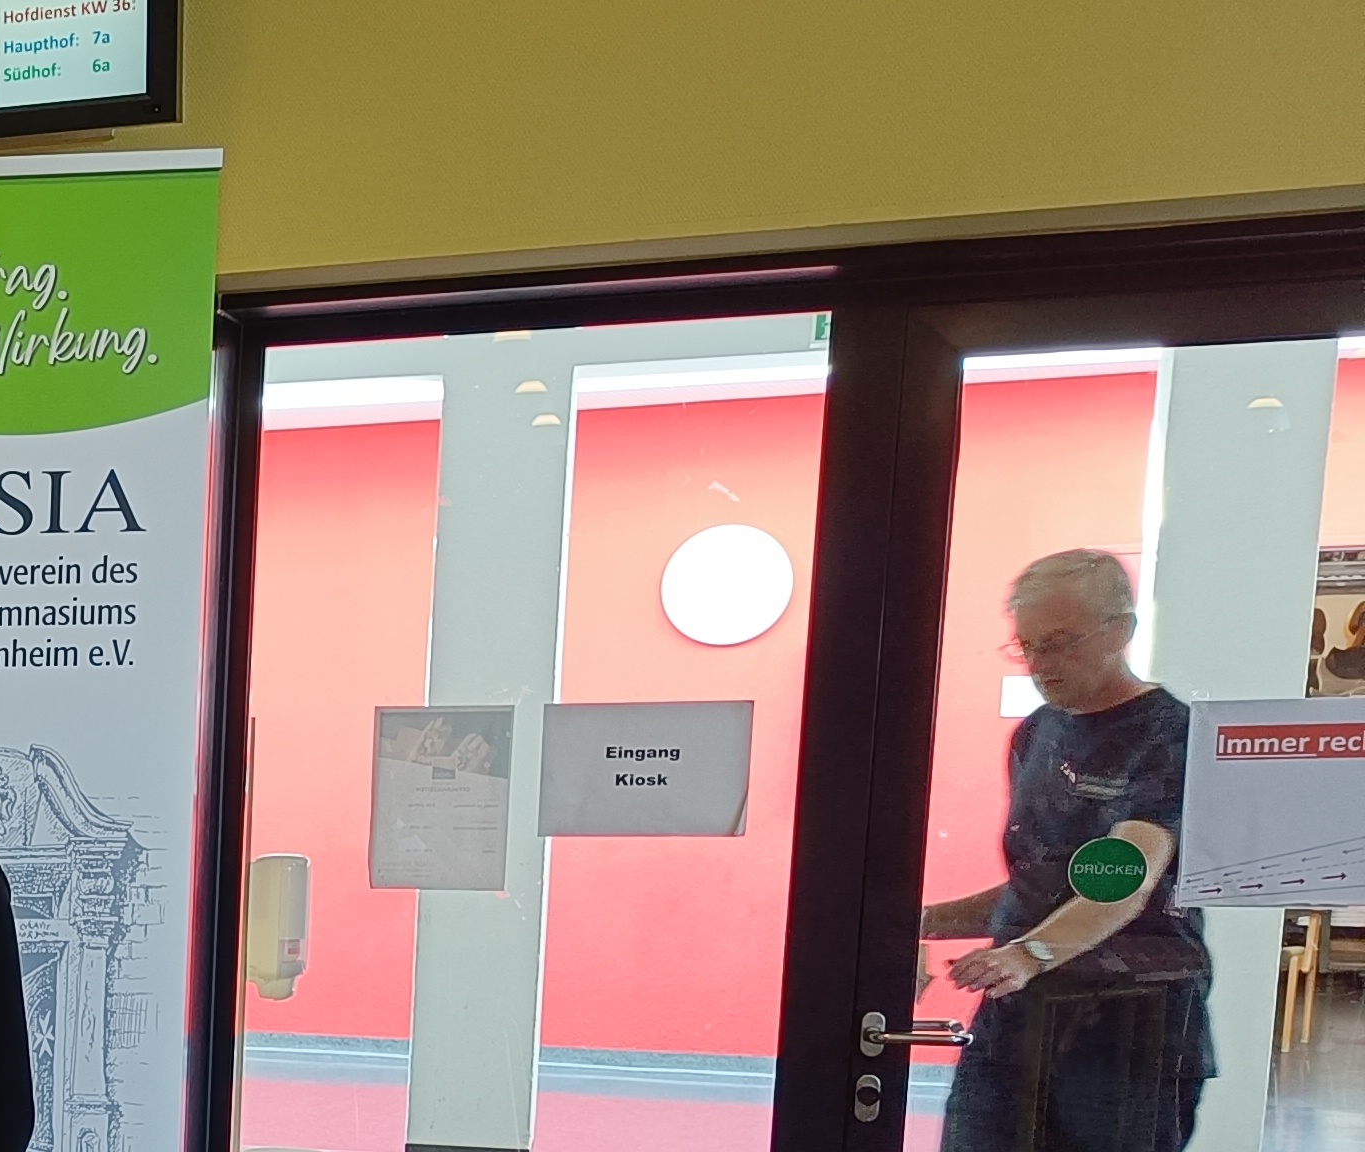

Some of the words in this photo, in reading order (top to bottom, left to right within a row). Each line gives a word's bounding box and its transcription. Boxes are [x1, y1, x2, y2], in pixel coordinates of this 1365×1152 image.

[3, 5, 76, 24] Hofdienst
[81, 1, 107, 15] KW
[112, 0, 136, 12] 36:
[4, 33, 79, 54] Haupthof:
[93, 31, 110, 45] 7a
[4, 63, 61, 81] Südhof:
[93, 59, 110, 73] 6a
[91, 555, 139, 584] des
[88, 638, 134, 668] e.V.
[606, 746, 680, 761] Eingang
[1218, 734, 1311, 754] Immer
[615, 774, 668, 786] Kiosk
[1073, 861, 1145, 877] DRÜCKEN
